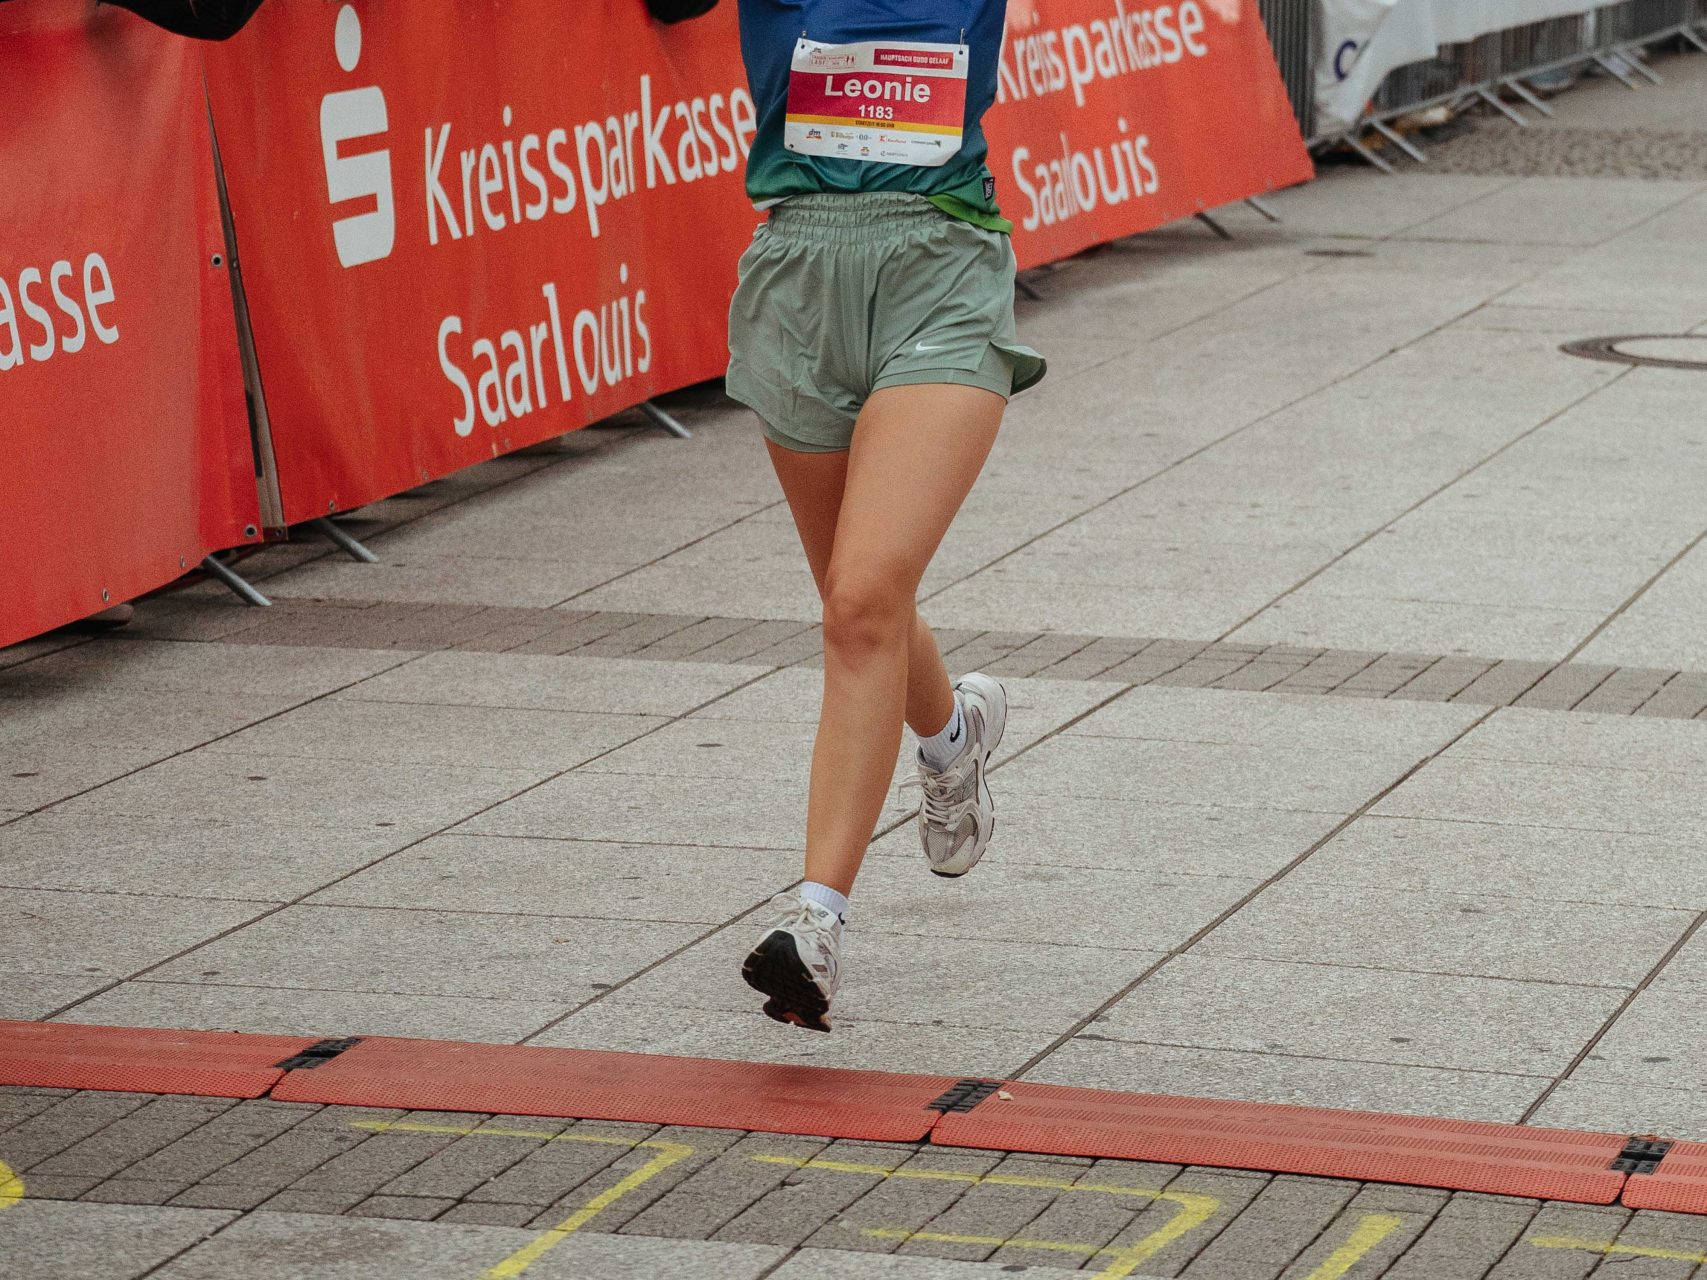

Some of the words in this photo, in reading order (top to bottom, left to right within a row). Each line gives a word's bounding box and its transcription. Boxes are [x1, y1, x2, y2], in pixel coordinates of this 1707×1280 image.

[825, 75, 931, 104] Leonie
[858, 104, 894, 120] 1183
[424, 73, 757, 246] Kreissparkasse
[1012, 116, 1159, 233] Saalouis
[0, 251, 120, 371] asse
[437, 262, 652, 438] Saarlouis
